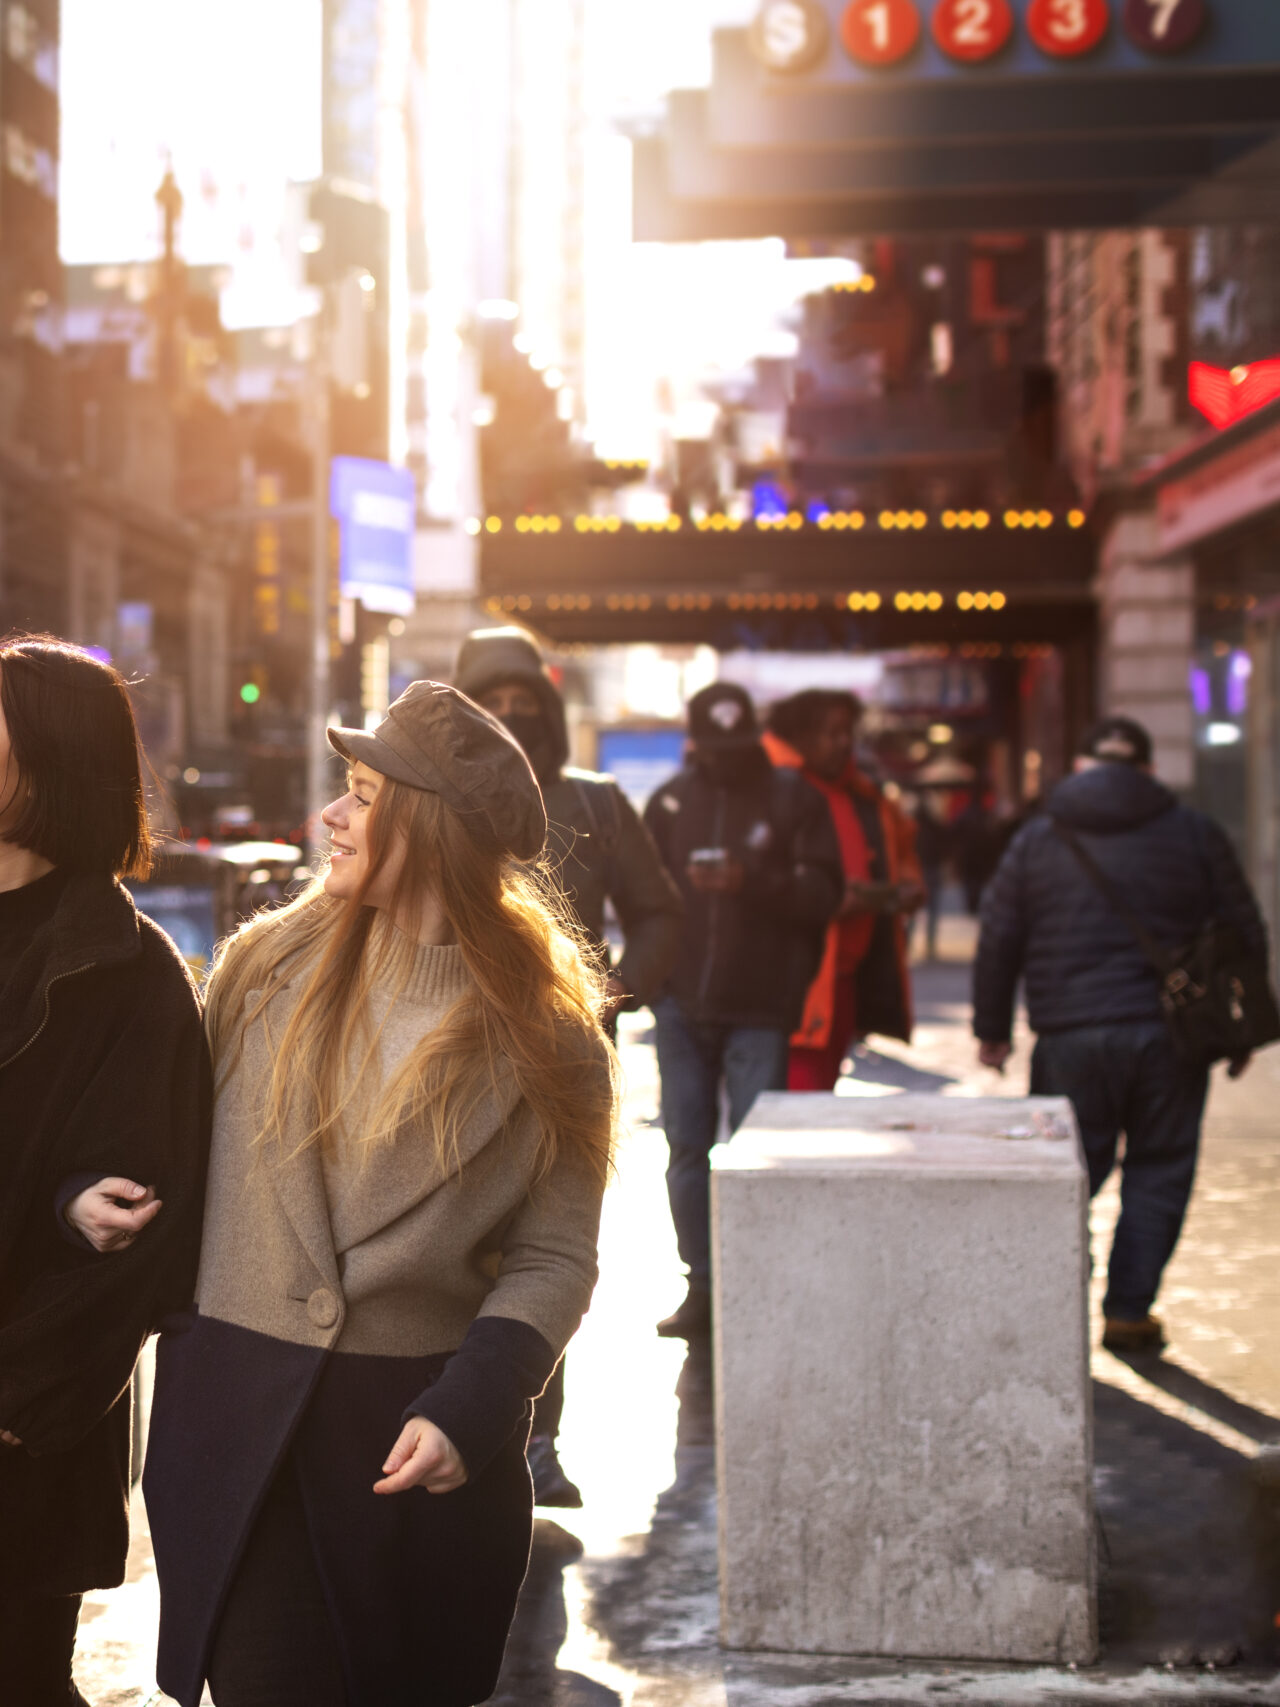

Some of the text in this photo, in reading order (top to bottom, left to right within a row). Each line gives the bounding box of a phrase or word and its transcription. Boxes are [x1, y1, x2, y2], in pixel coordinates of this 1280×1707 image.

[764, 0, 1181, 60] S 1 2 3 7
